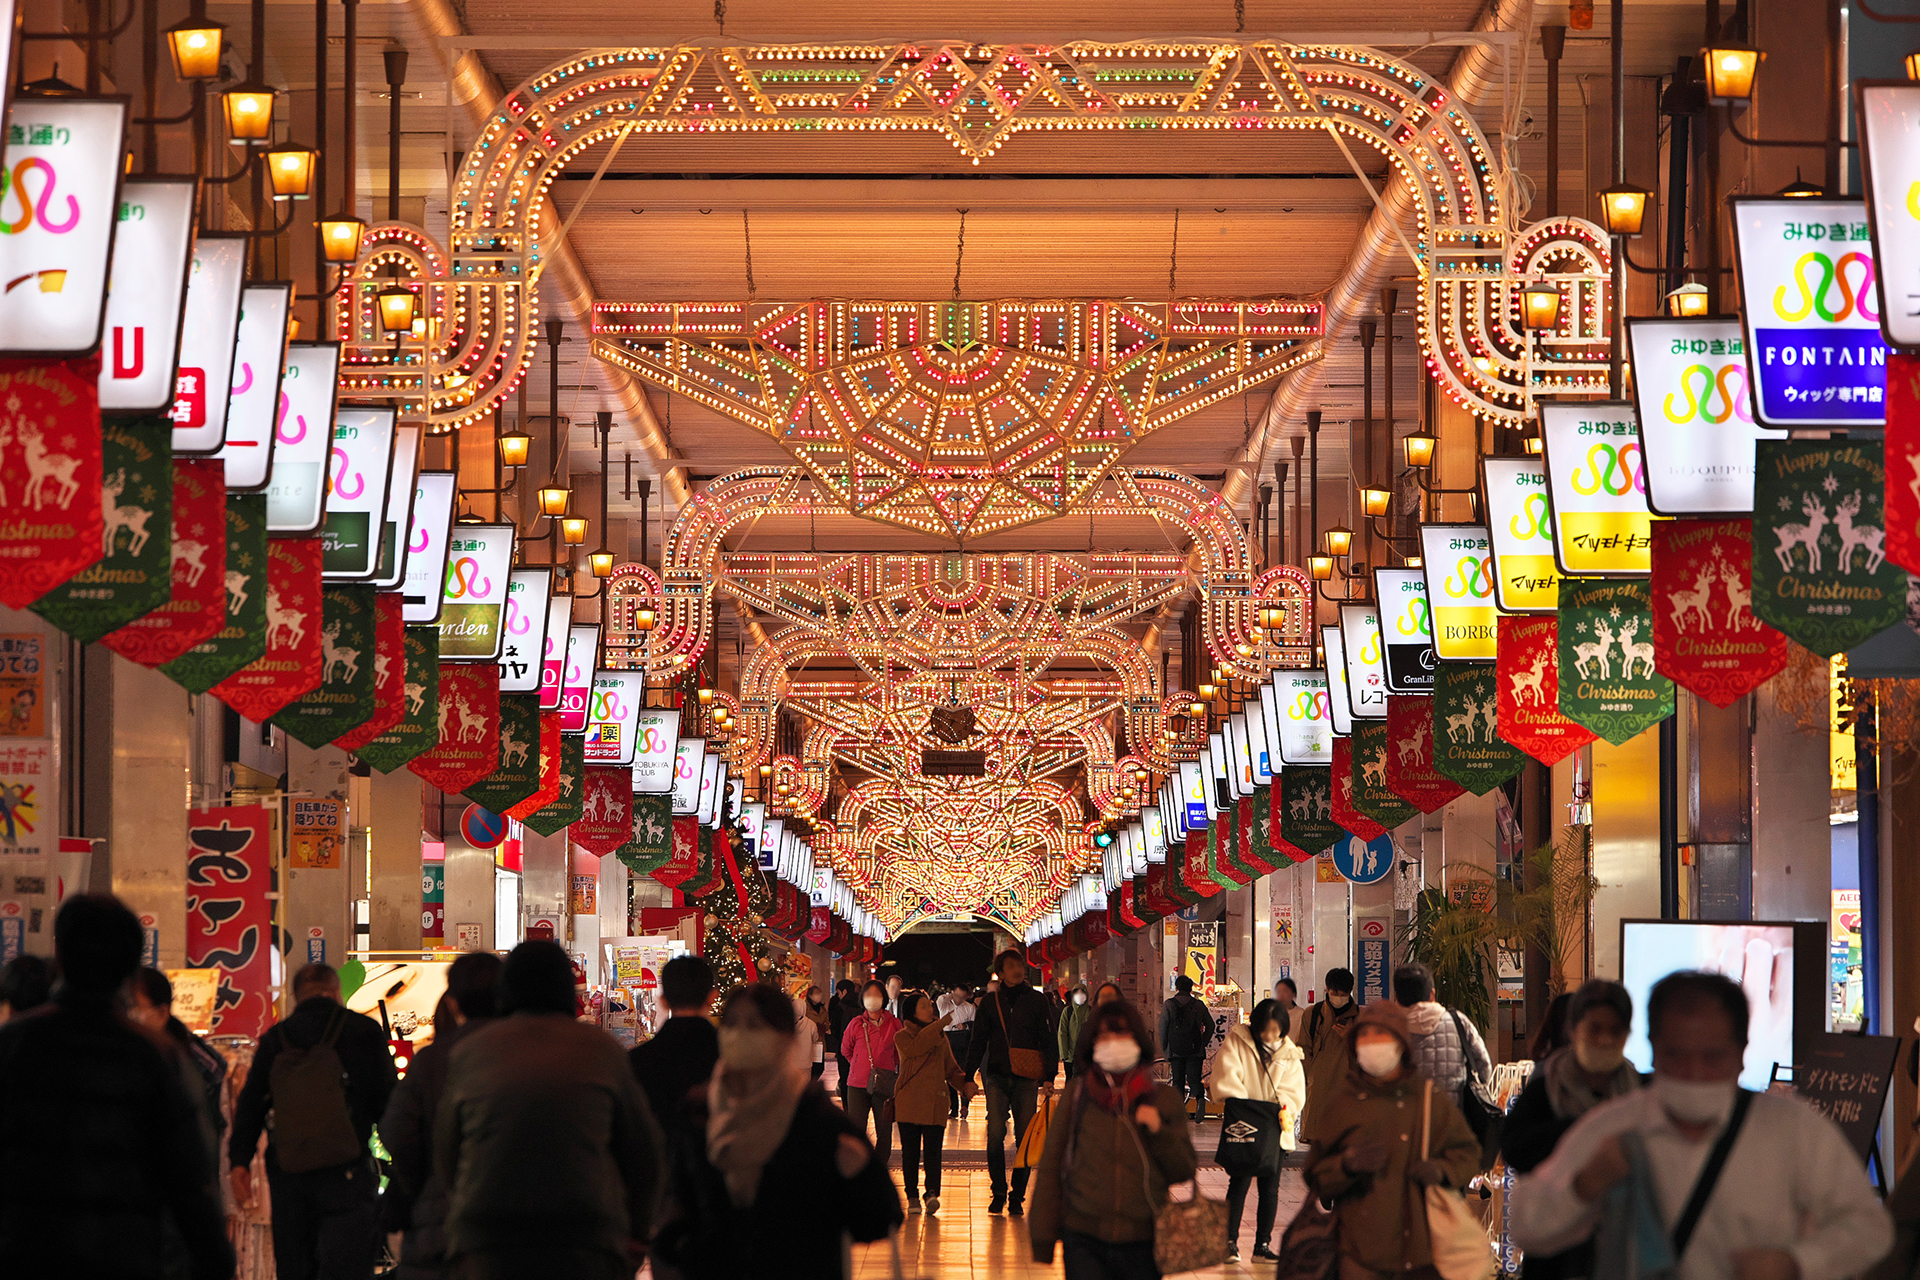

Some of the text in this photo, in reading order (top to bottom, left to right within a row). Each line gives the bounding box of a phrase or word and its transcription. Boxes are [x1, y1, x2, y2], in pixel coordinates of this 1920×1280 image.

[1783, 386, 1884, 403] ウィッグ専門店
[1775, 452, 1830, 479] Happy
[1776, 575, 1882, 602] Christmas
[1573, 584, 1616, 610] Happy
[1806, 603, 1852, 616] みゆき通り
[1511, 621, 1548, 643] Happy
[1674, 637, 1767, 657] Christmas
[1701, 659, 1741, 669] みゆき通り
[1446, 668, 1480, 688] Happy
[1577, 682, 1658, 701] Christmas
[1399, 699, 1428, 715] Happy
[1599, 702, 1634, 713] みゆき通り
[603, 725, 618, 741] 薬
[1535, 727, 1566, 736] みゆき通り
[584, 748, 620, 756] サンドラッグ
[1448, 745, 1512, 760] Christmas
[295, 802, 338, 813] 自転車から
[295, 813, 338, 827] 降りてね
[1291, 821, 1335, 832] Christmas
[579, 823, 623, 834] Christmas
[624, 844, 664, 855] Christmas
[423, 881, 433, 889] 2F
